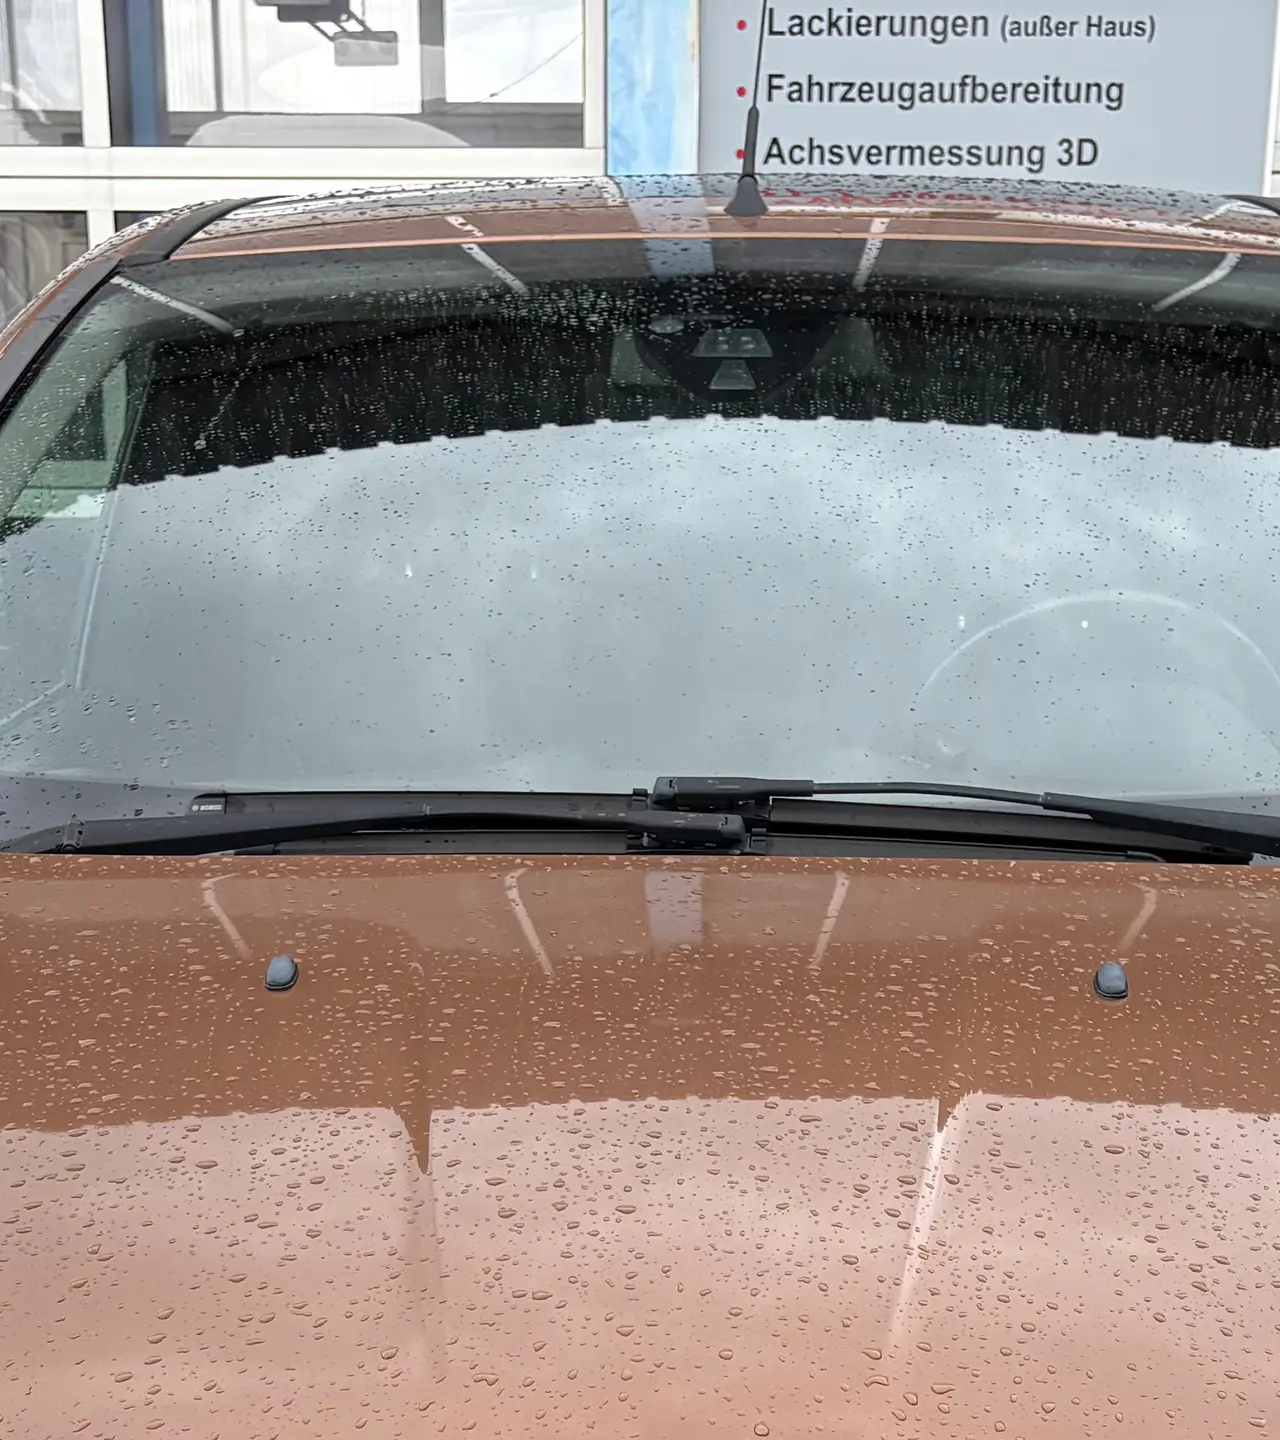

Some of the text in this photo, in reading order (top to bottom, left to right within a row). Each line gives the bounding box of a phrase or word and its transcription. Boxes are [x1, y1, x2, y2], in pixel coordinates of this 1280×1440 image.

[768, 7, 1156, 44] Lackierungen (außer Haus)
[767, 74, 1124, 111] Fahrzeugaufbereitung
[763, 137, 1099, 173] Achsvermessung 3D
